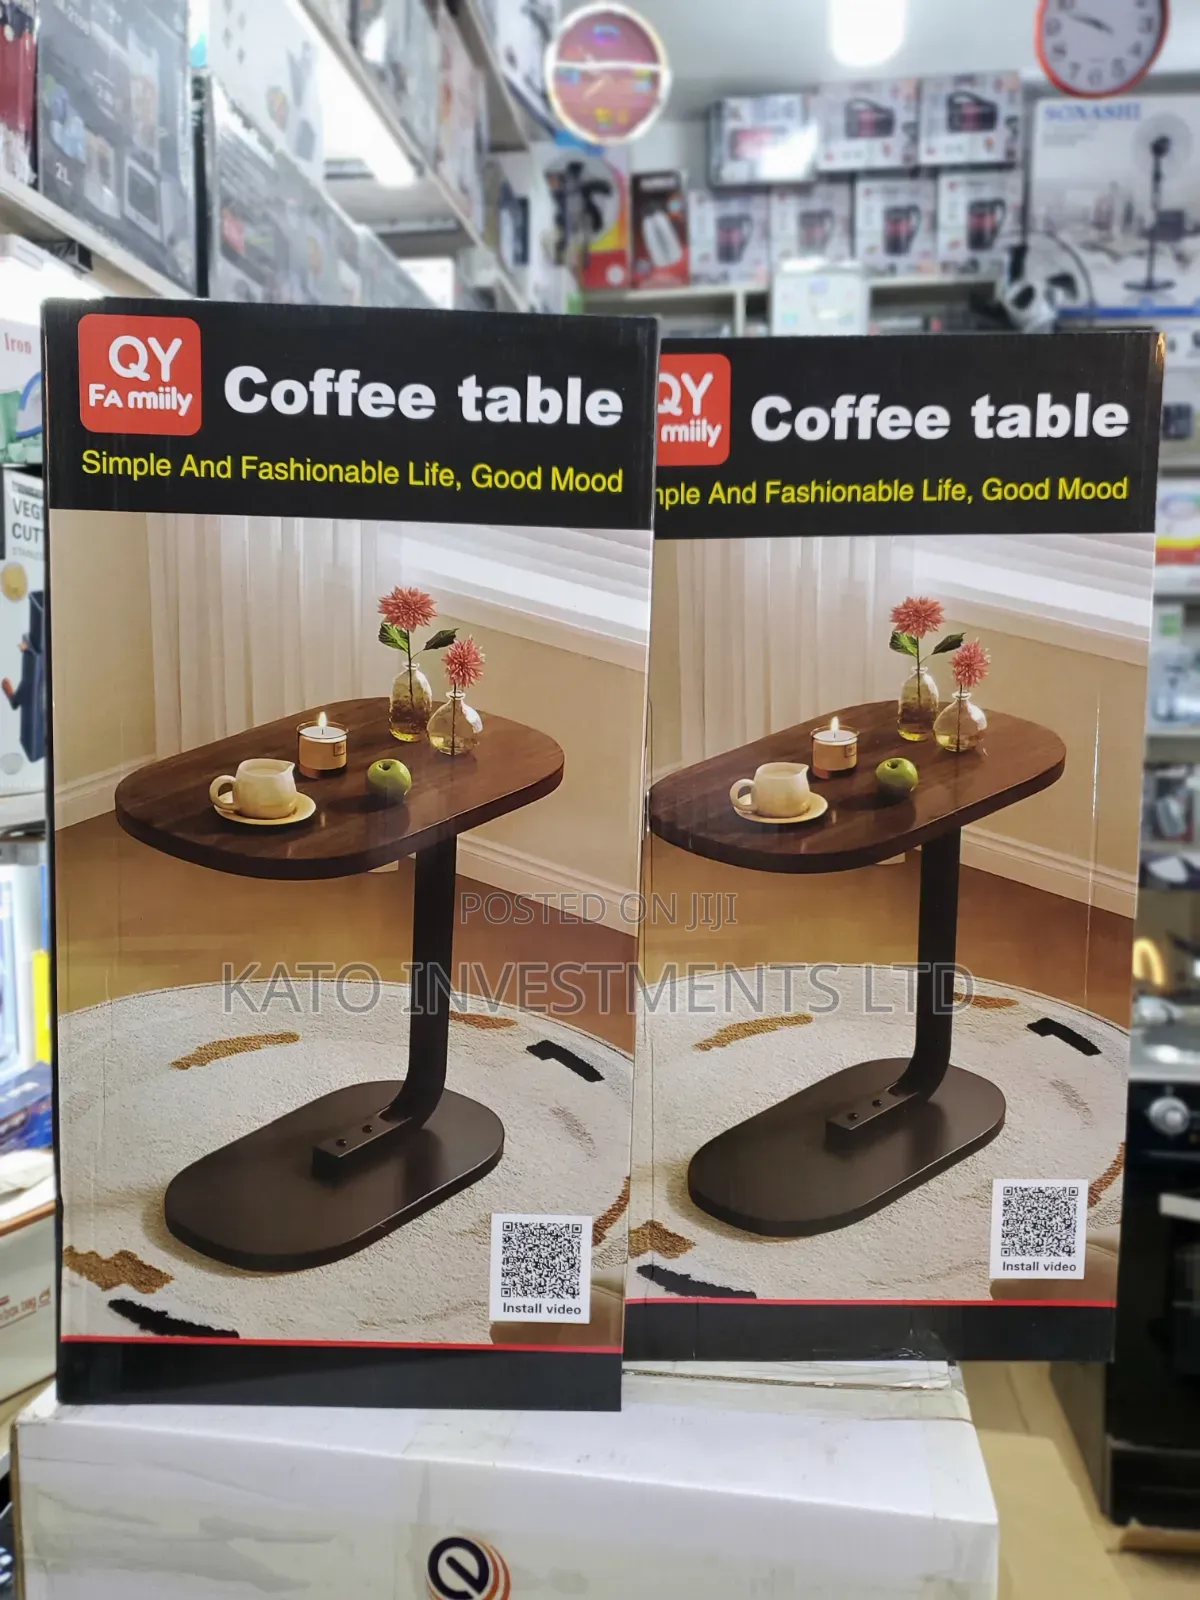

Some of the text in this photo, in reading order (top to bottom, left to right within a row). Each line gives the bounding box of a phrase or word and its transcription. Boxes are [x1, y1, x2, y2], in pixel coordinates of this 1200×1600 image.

[4, 331, 32, 355] Iron
[108, 334, 183, 383] QY
[224, 365, 623, 426] Coffee table
[656, 371, 714, 417] QY
[751, 392, 1129, 442] Coffee table
[81, 449, 623, 493] Simple And Fashionable Life, Good Mood
[708, 481, 757, 505] And
[765, 479, 914, 505] Fashionable
[922, 478, 973, 506] Life,
[982, 477, 1050, 502] Good
[1058, 476, 1128, 501] Mood
[12, 497, 44, 521] VEG
[12, 522, 44, 543] CUT
[1002, 1261, 1077, 1272] Install video
[502, 1302, 582, 1315] Install video
